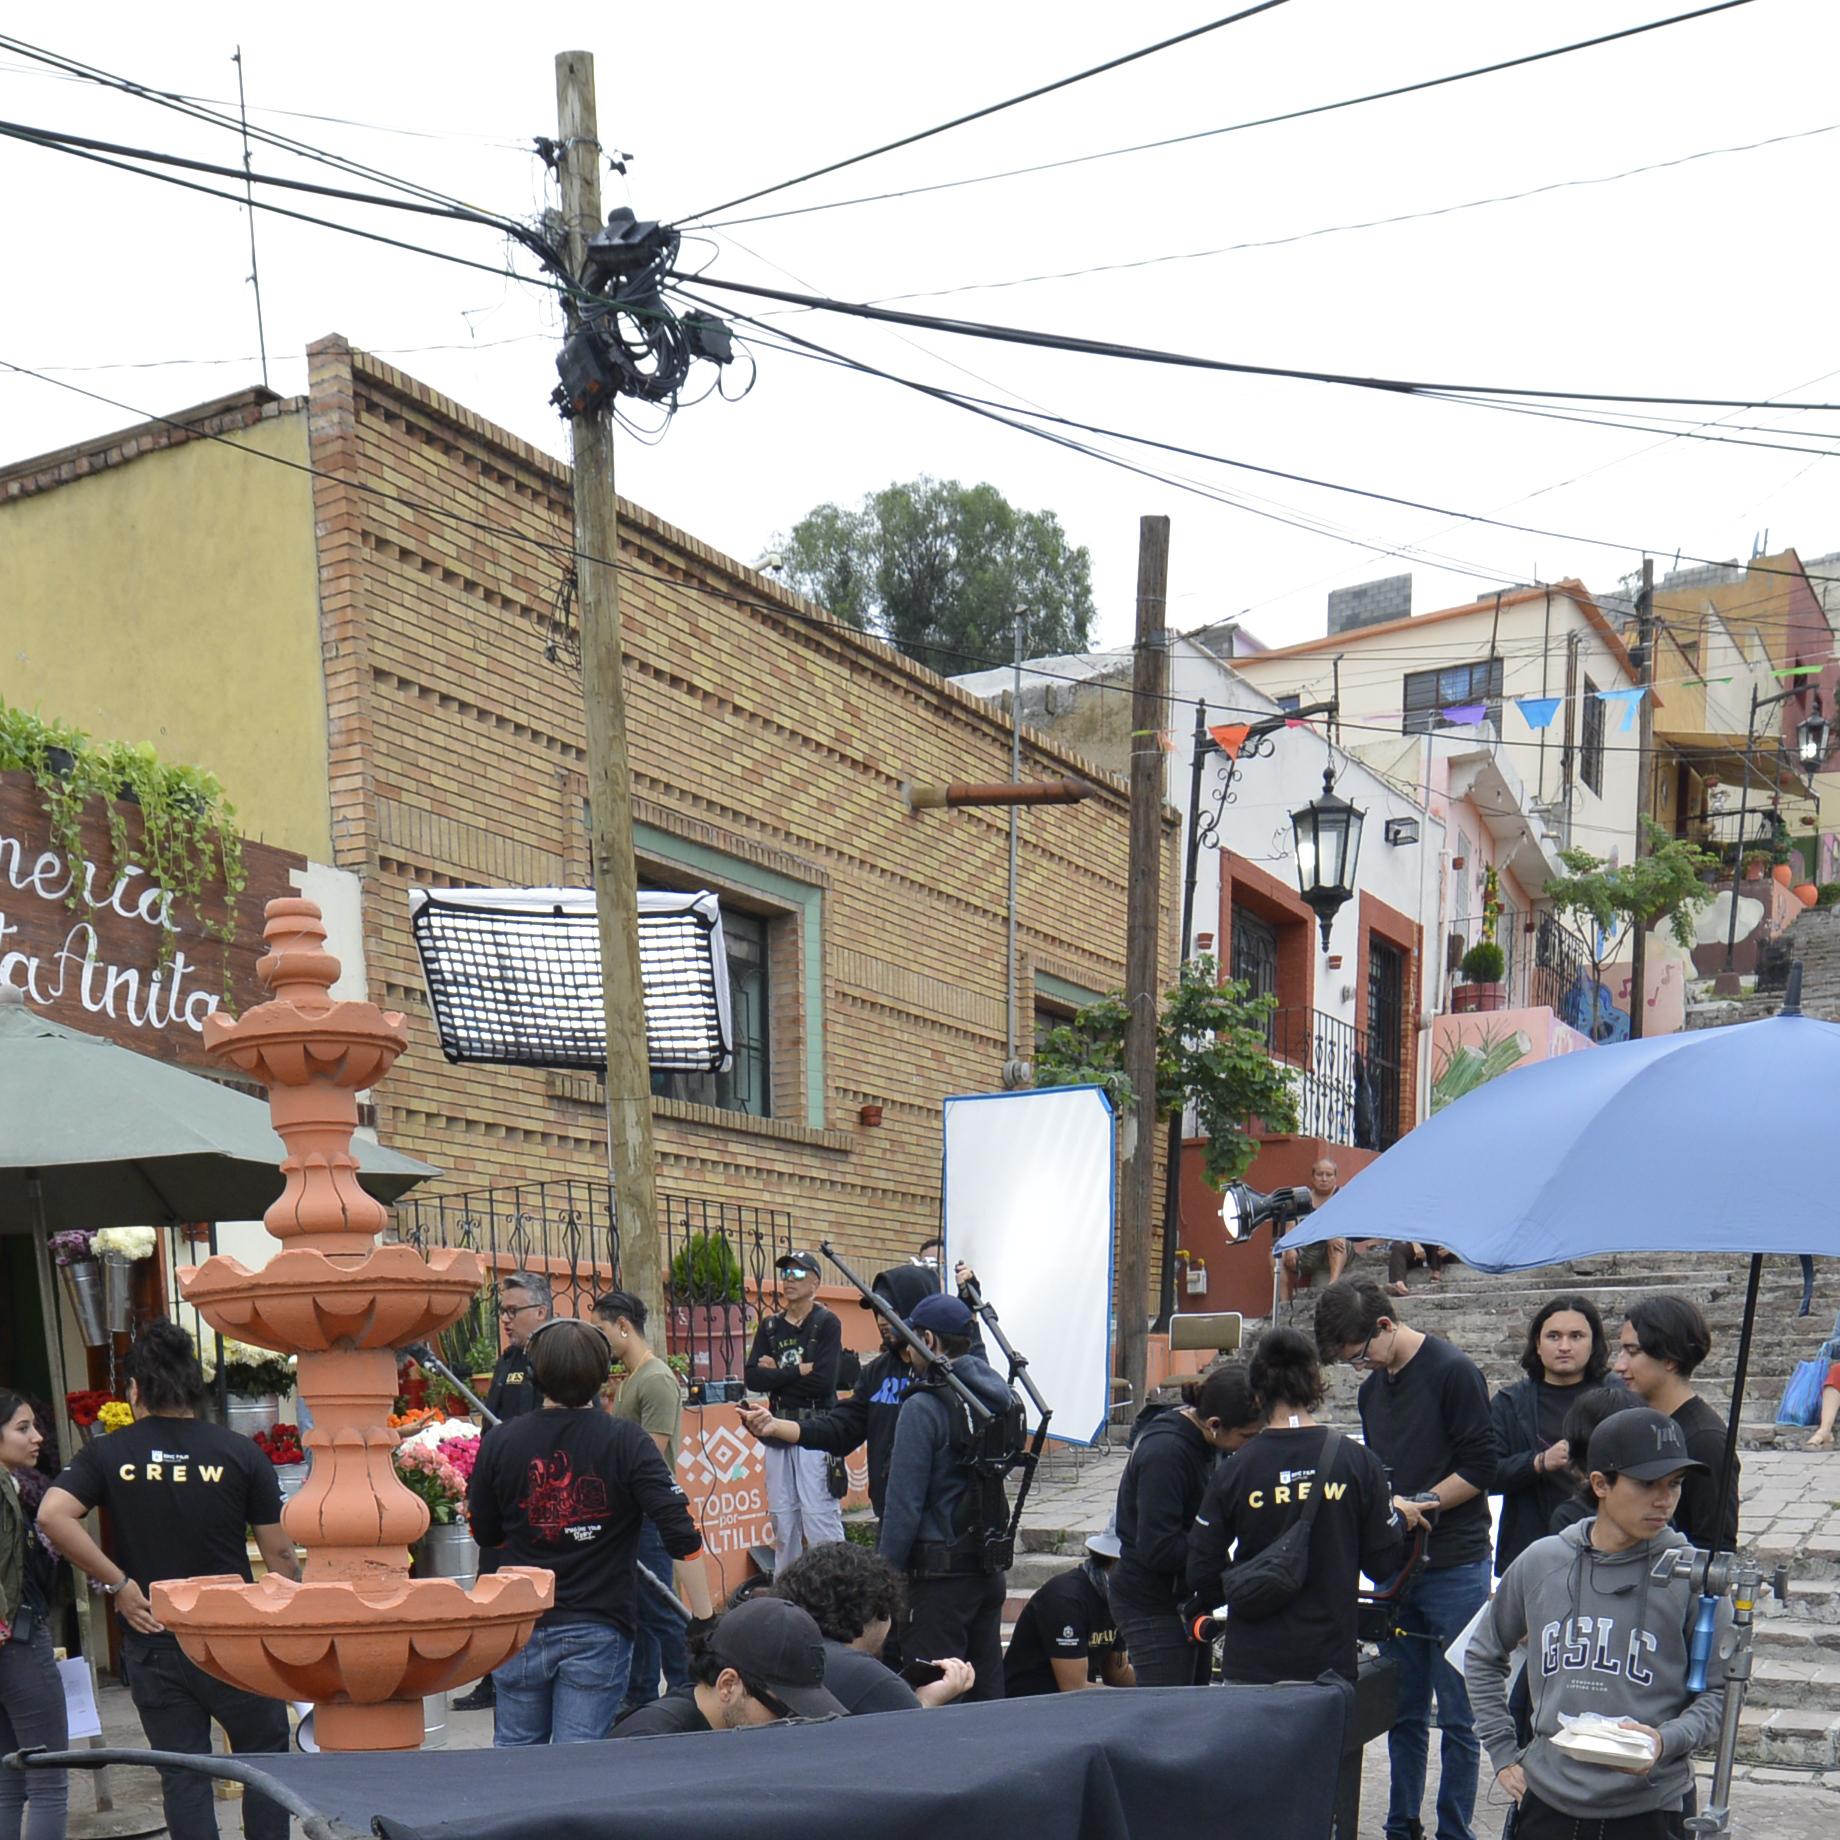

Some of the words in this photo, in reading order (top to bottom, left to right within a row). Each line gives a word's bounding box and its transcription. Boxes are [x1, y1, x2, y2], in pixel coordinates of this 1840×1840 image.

[48, 921, 221, 1032] Anita
[119, 1463, 224, 1482] CREW
[694, 1488, 762, 1516] TODOS
[1248, 1482, 1347, 1509] CREW
[719, 1513, 739, 1528] por
[701, 1522, 776, 1555] LTILLO
[1541, 1616, 1657, 1686] GSLC
